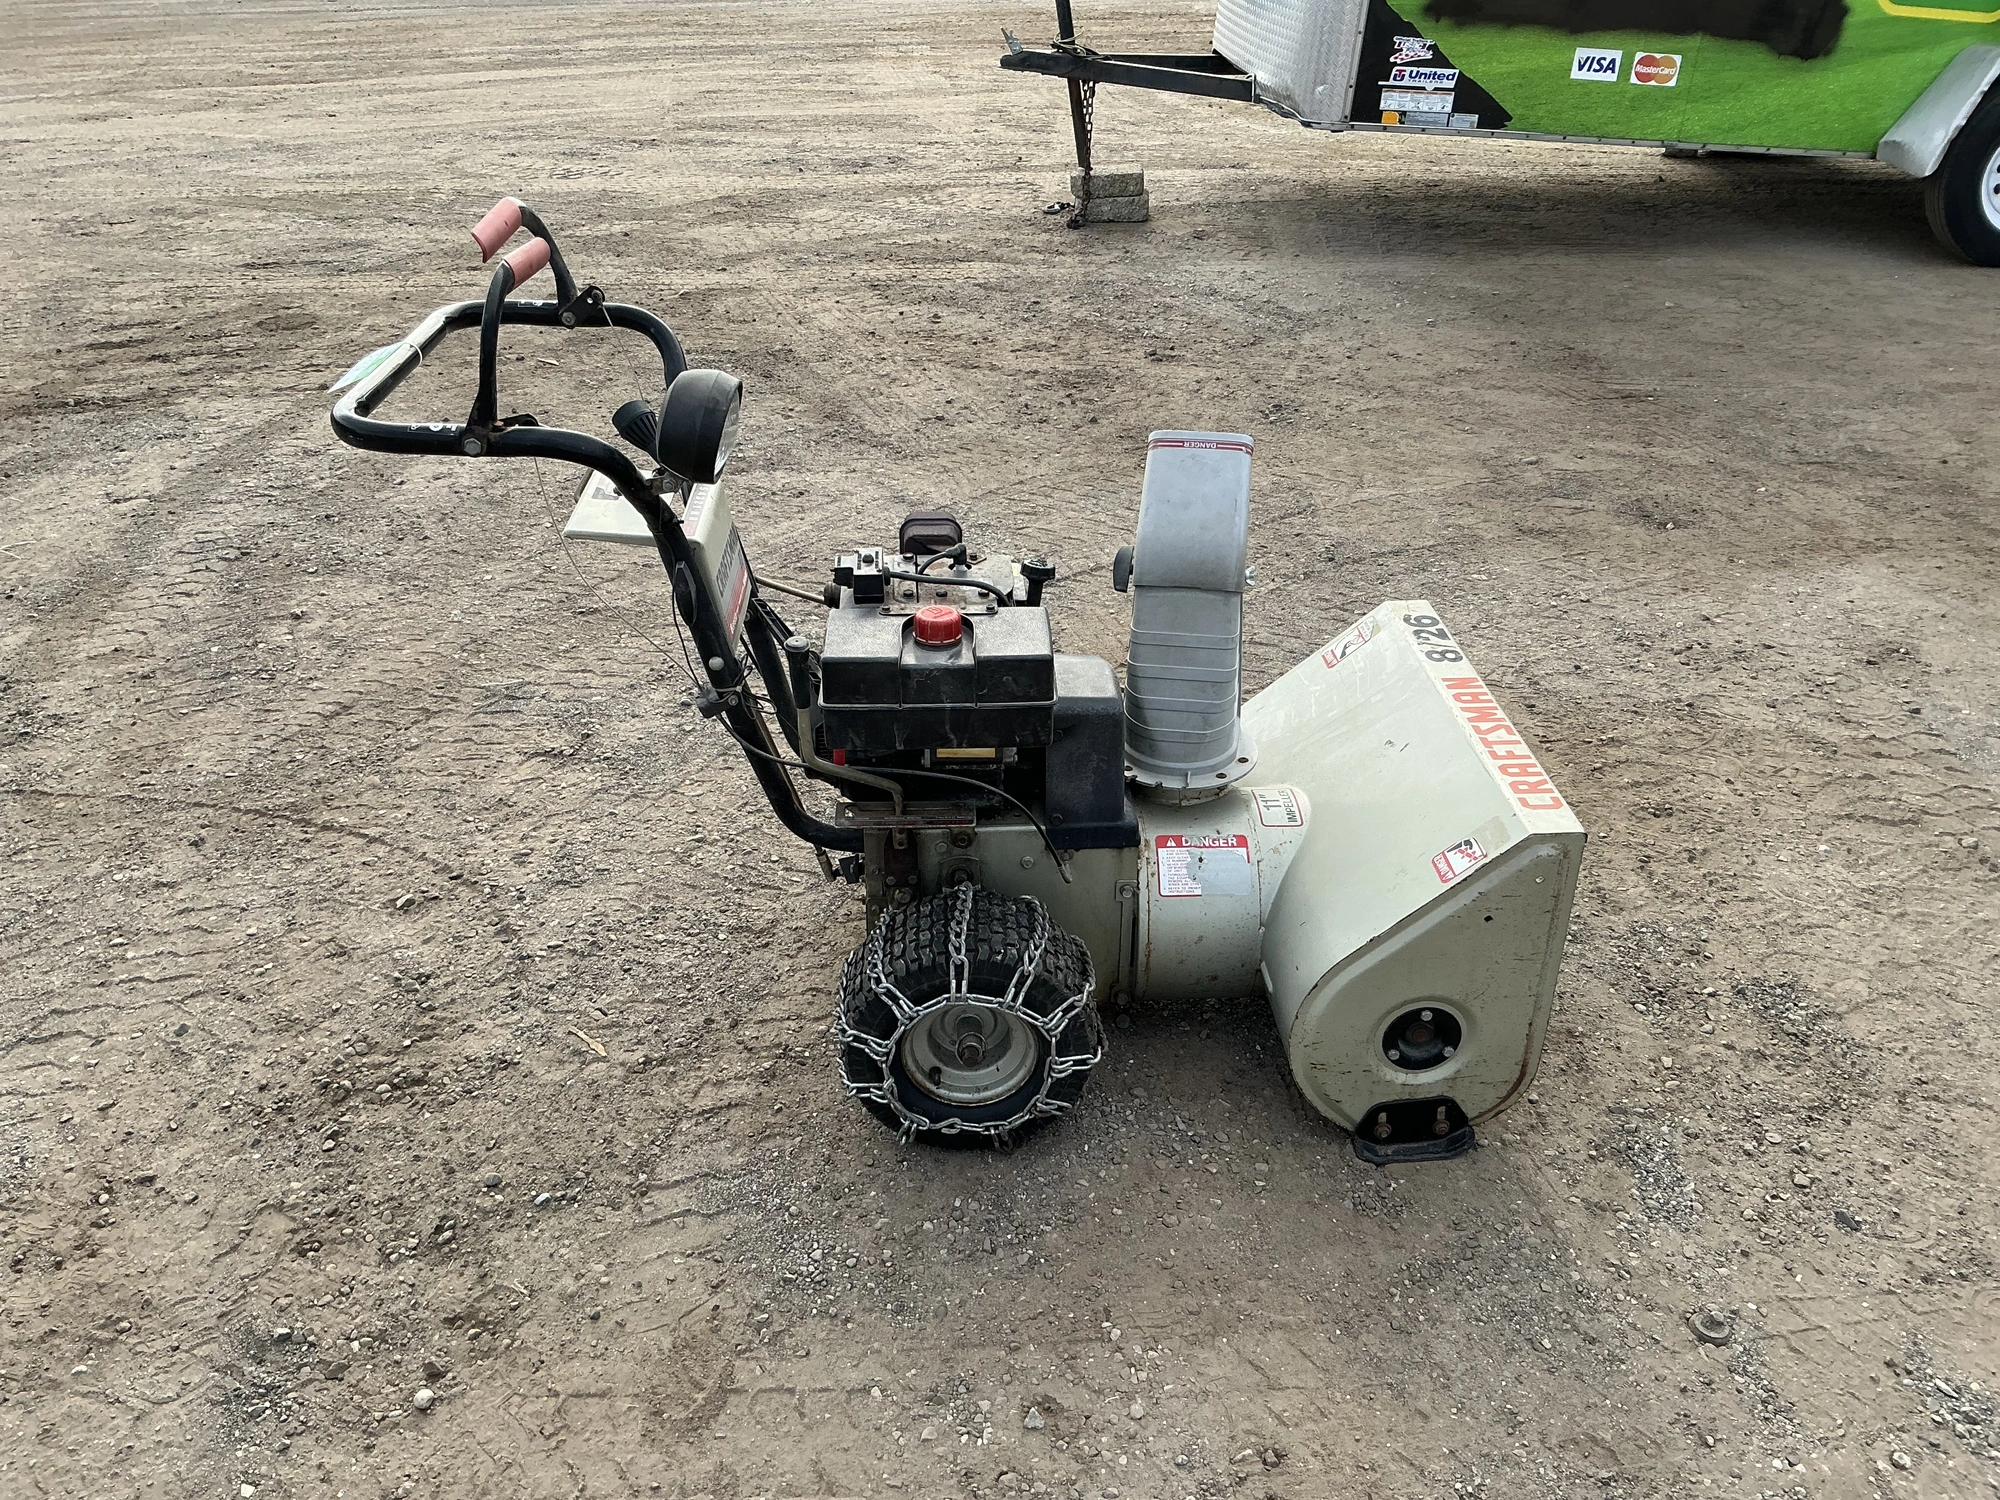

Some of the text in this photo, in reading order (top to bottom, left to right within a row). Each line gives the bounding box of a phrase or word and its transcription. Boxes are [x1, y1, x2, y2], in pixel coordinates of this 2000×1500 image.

[1577, 55, 1617, 74] VISA
[1635, 64, 1677, 75] MasterCard
[1408, 70, 1457, 82] United
[1183, 441, 1217, 449] DANGER
[1403, 614, 1564, 810] CRAFTSMAN 8/26
